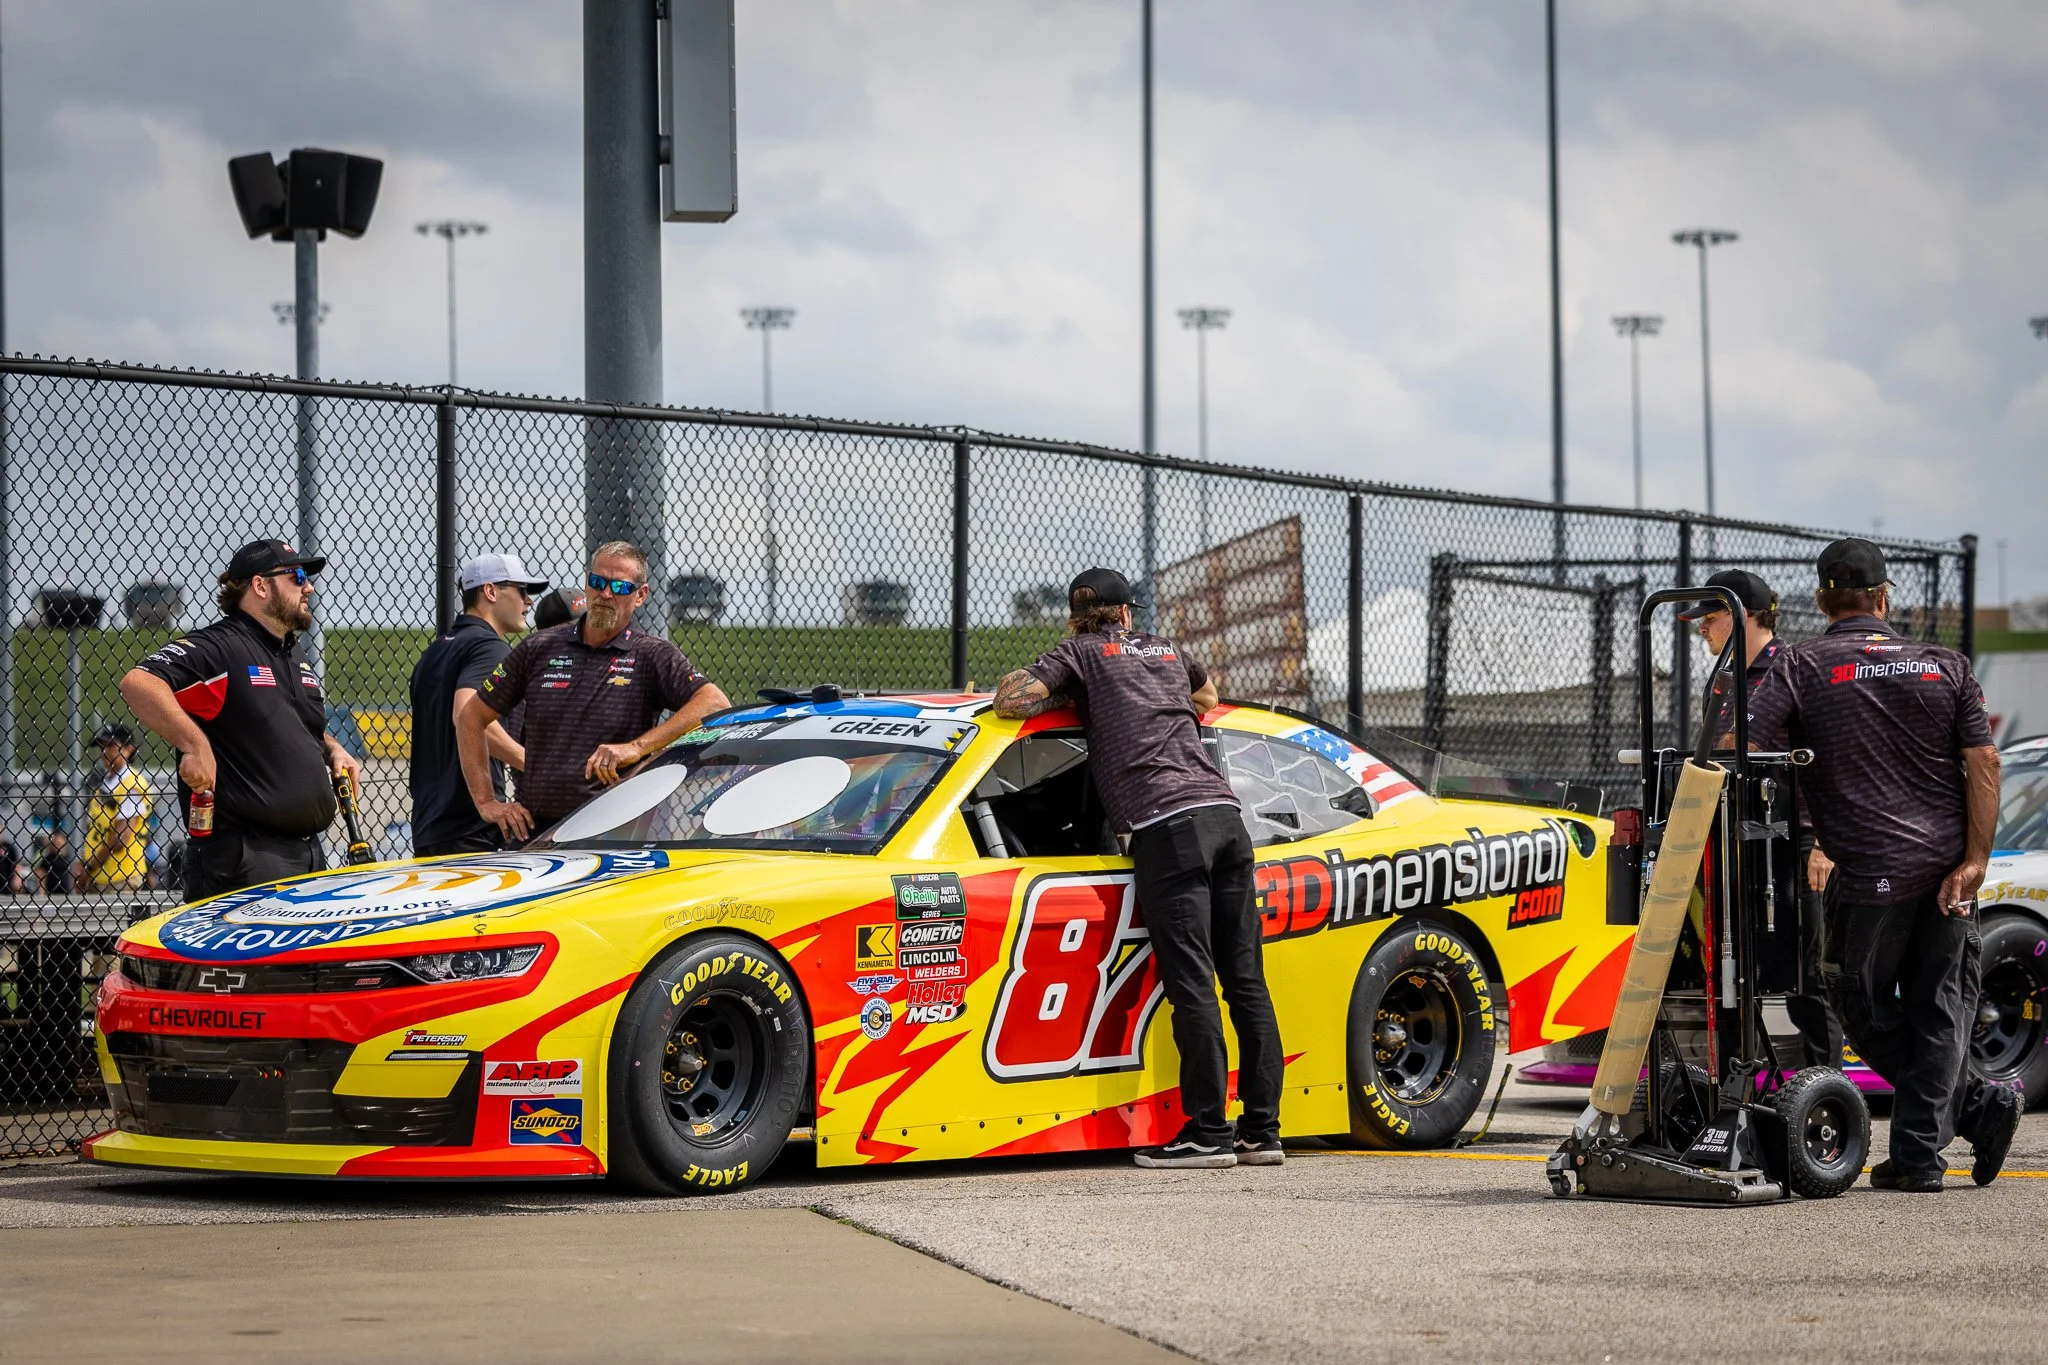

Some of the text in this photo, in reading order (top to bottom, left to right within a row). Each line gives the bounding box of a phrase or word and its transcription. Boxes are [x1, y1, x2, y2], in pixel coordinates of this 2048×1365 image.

[1831, 659, 1941, 685] 3Dimensional
[830, 721, 932, 738] GREEN
[1253, 818, 1569, 938] 3Dimensional
[902, 886, 938, 905] O'Reilly
[941, 886, 957, 895] AUTO
[940, 895, 961, 904] PARTS
[1510, 884, 1564, 924] .com
[922, 910, 941, 919] SERIES
[172, 920, 226, 949] SEAL
[901, 924, 963, 943] COMETIC
[857, 960, 894, 969] KENNAMETAL
[902, 951, 955, 965] LINCOLN
[857, 975, 894, 986] FIVE STAR
[915, 966, 961, 979] WELDERS
[985, 872, 1167, 1079] 87
[908, 981, 967, 1007] Holley
[864, 999, 889, 1013] CHAMPION
[150, 1008, 266, 1031] CHEVROLET
[905, 1004, 958, 1025] MSD
[411, 1034, 468, 1043] PETERSON
[863, 1024, 890, 1038] IRRIGATION
[487, 1060, 579, 1081] ARP
[548, 1079, 580, 1087] products
[1363, 1081, 1410, 1136] EAGLE
[515, 1116, 578, 1128] SUNOCO
[1702, 1128, 1730, 1144] 3 TON
[1691, 1144, 1729, 1153] DAYTONA
[682, 1160, 749, 1187] EAGLE
